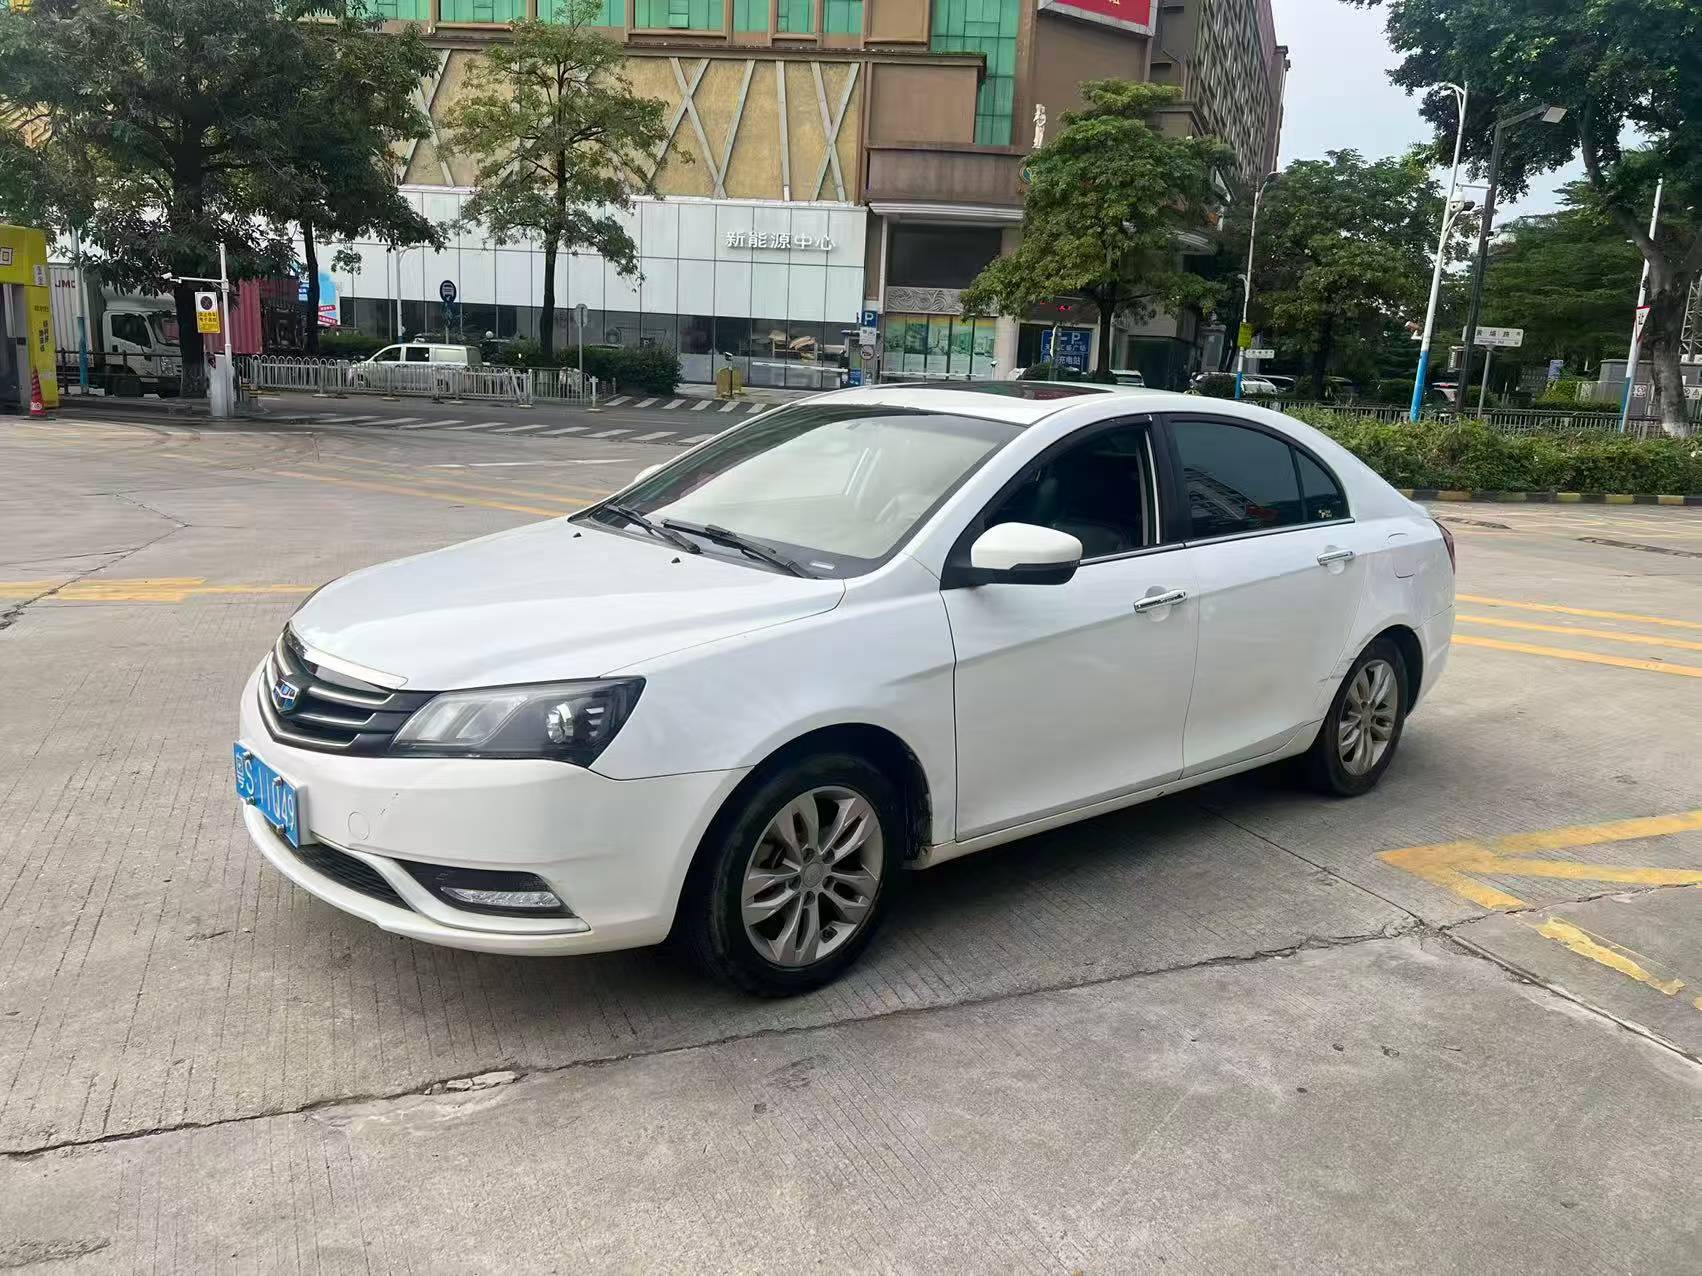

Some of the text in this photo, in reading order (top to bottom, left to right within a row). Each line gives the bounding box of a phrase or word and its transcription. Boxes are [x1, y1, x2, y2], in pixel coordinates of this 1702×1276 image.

[725, 231, 836, 251] 新能源中心
[54, 279, 76, 289] JMC
[864, 312, 874, 325] P
